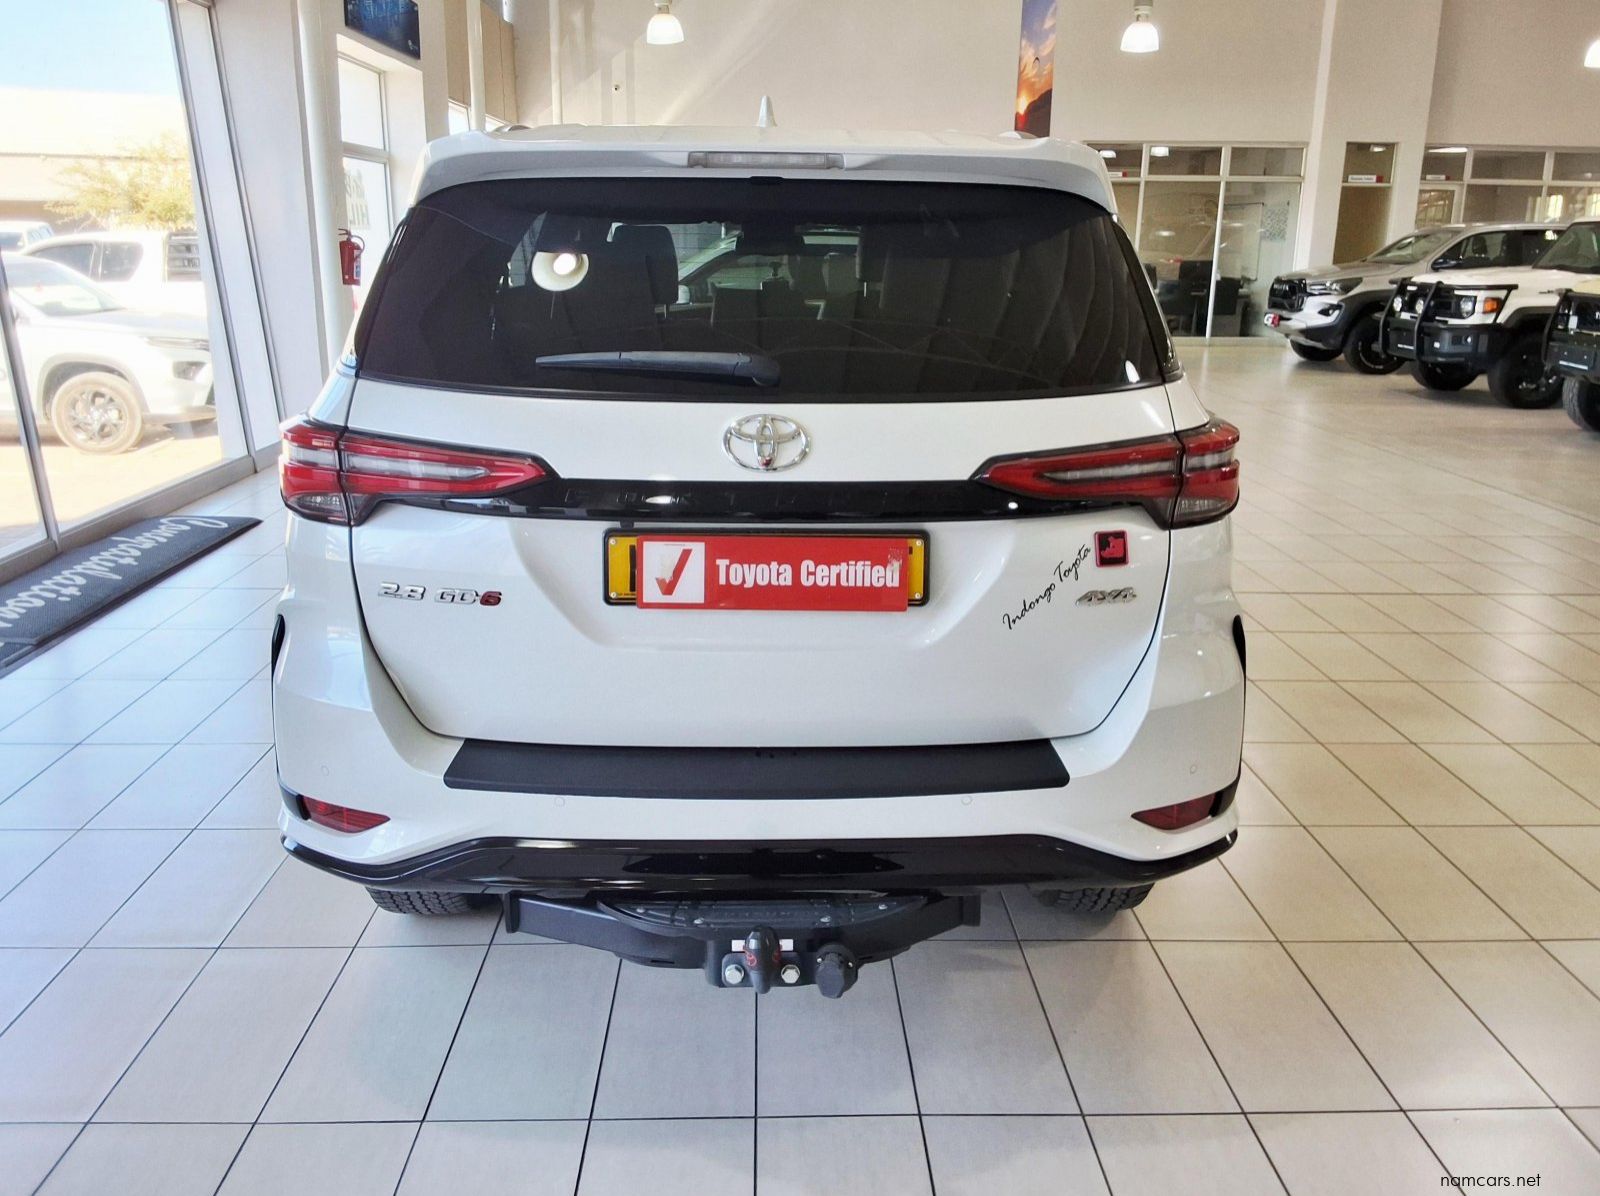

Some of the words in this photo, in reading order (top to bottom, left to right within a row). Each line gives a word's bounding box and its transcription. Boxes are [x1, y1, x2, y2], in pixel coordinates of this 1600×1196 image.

[715, 559, 792, 588] Toyota
[800, 559, 900, 588] Certified
[1002, 581, 1056, 630] Indongo
[1053, 543, 1091, 581] Toyota
